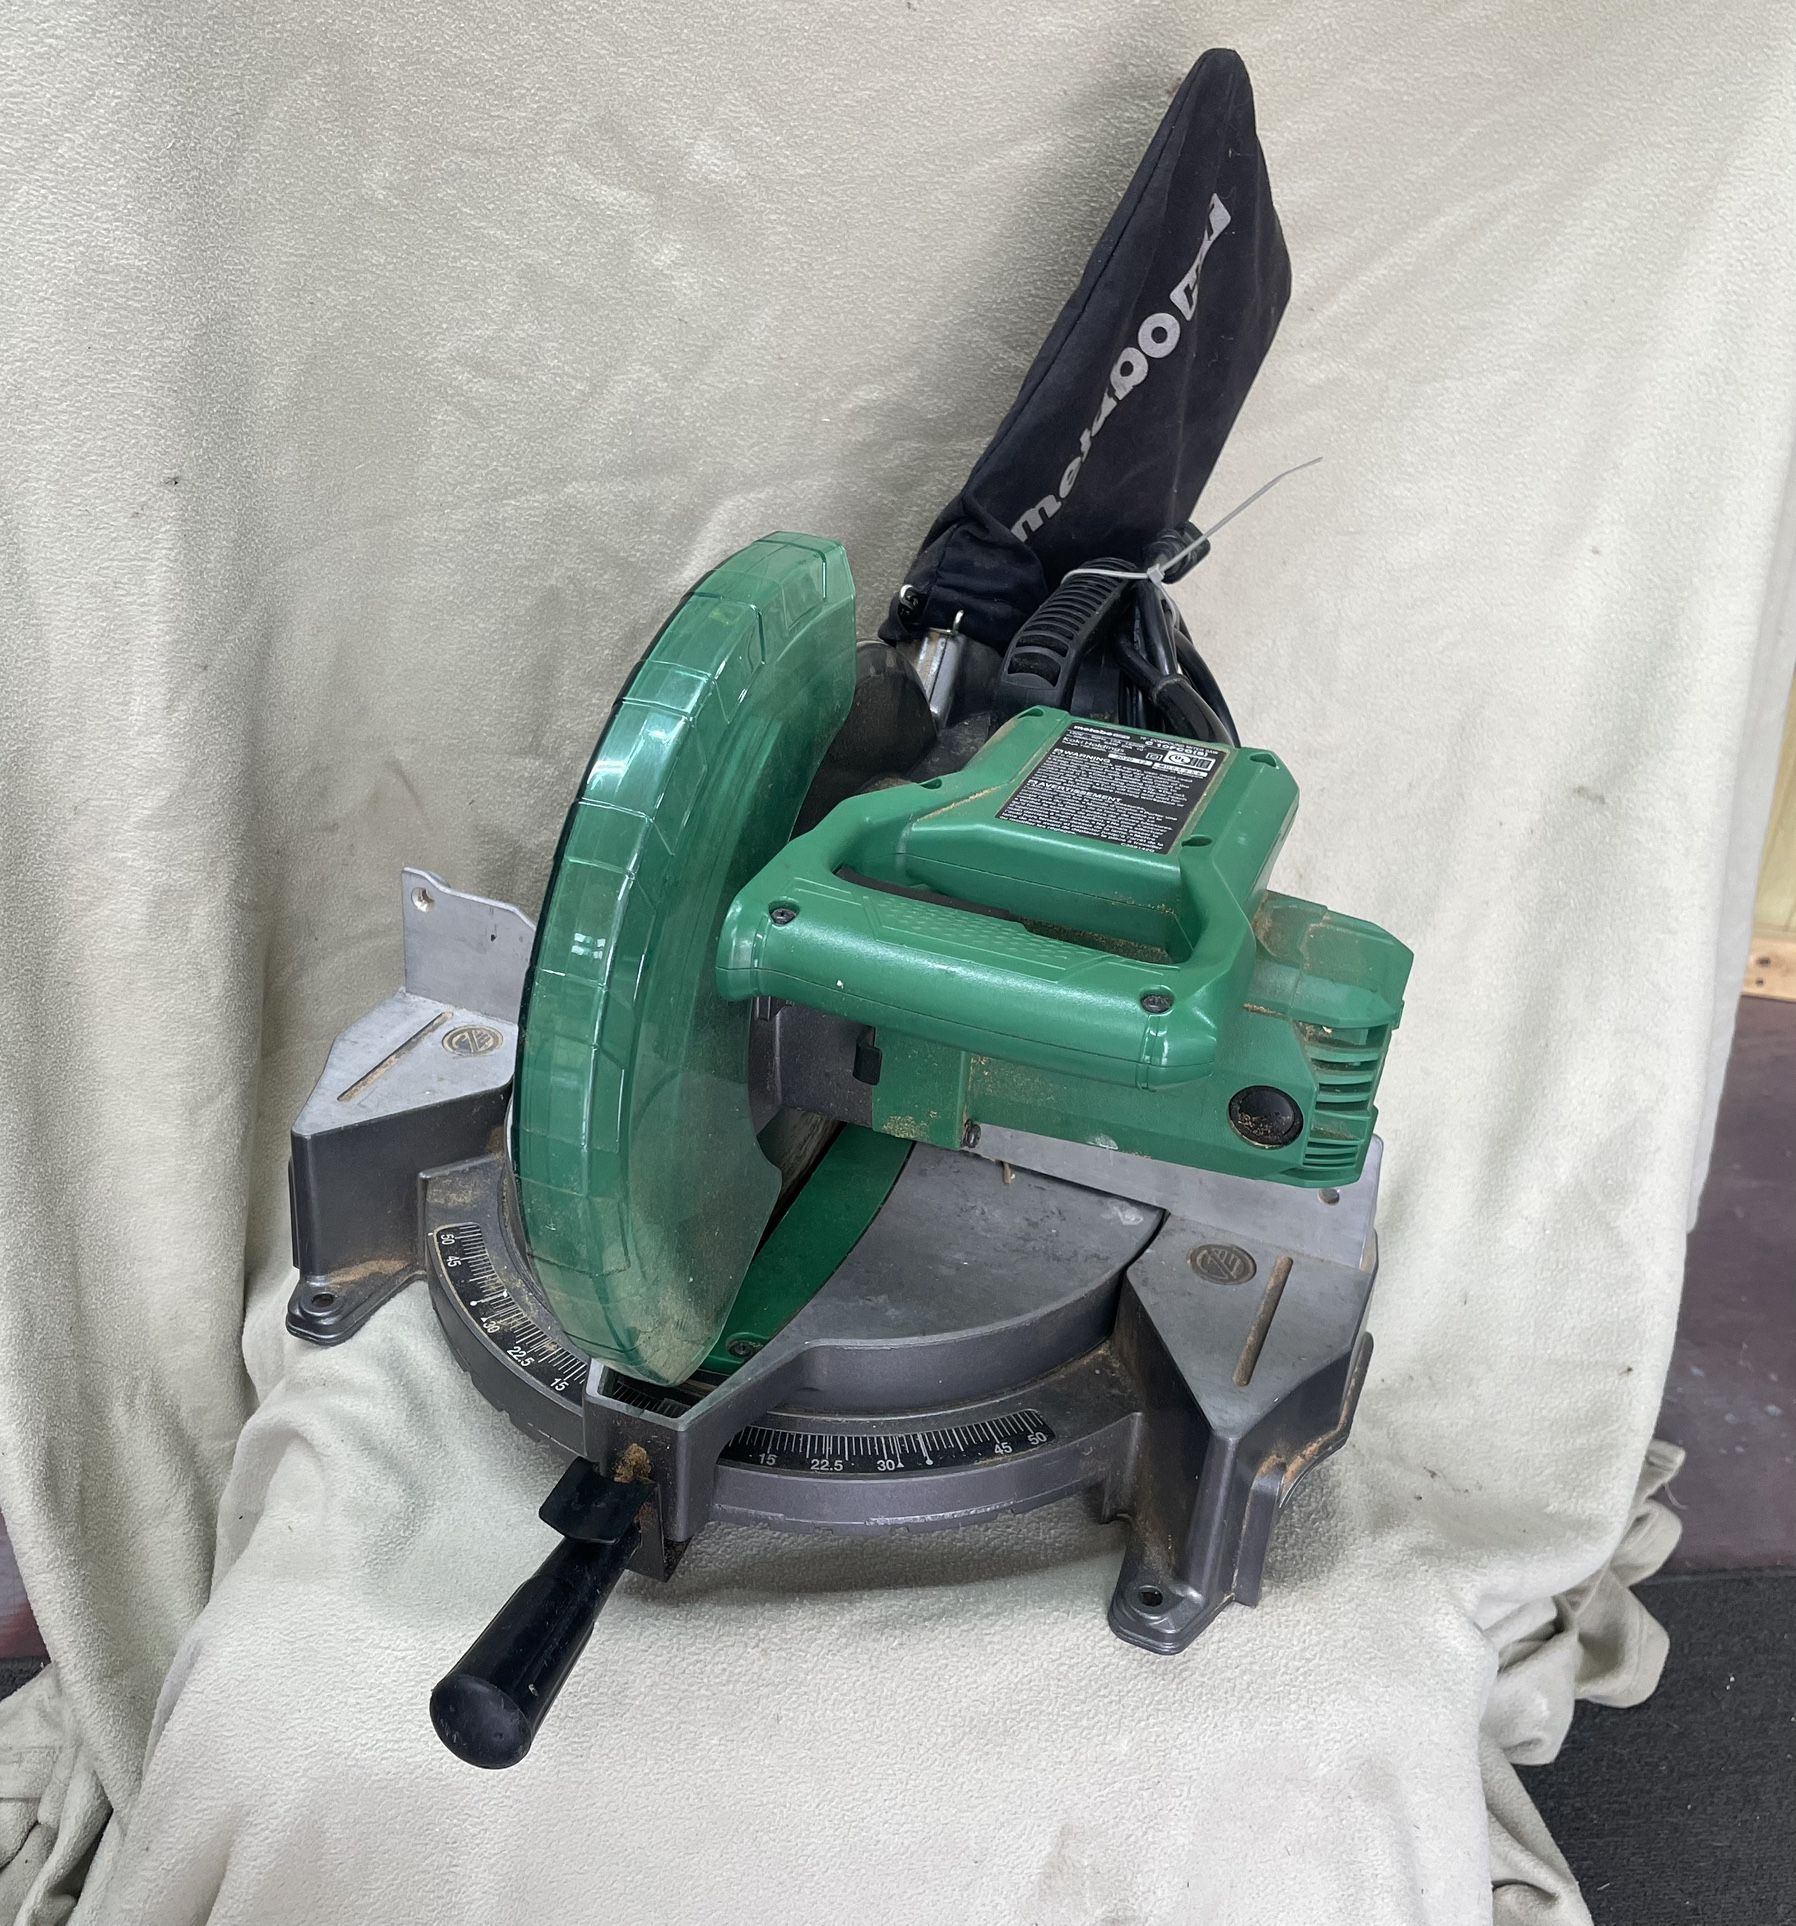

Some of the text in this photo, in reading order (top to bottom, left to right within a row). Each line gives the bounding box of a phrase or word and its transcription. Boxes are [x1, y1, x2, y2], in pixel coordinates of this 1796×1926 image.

[1084, 741, 1125, 753] Holdings
[1064, 750, 1111, 763] WARNING
[1037, 781, 1123, 803] AVERTISSEMENT
[440, 1233, 456, 1246] 50
[446, 1255, 462, 1268] 45
[482, 1320, 501, 1334] 30
[506, 1346, 535, 1367] 22.5
[550, 1377, 569, 1392] 15
[1027, 1432, 1048, 1446] 50
[993, 1442, 1014, 1455] 45
[758, 1453, 777, 1466] 15
[810, 1458, 844, 1472] 22.5
[876, 1459, 896, 1472] 30
